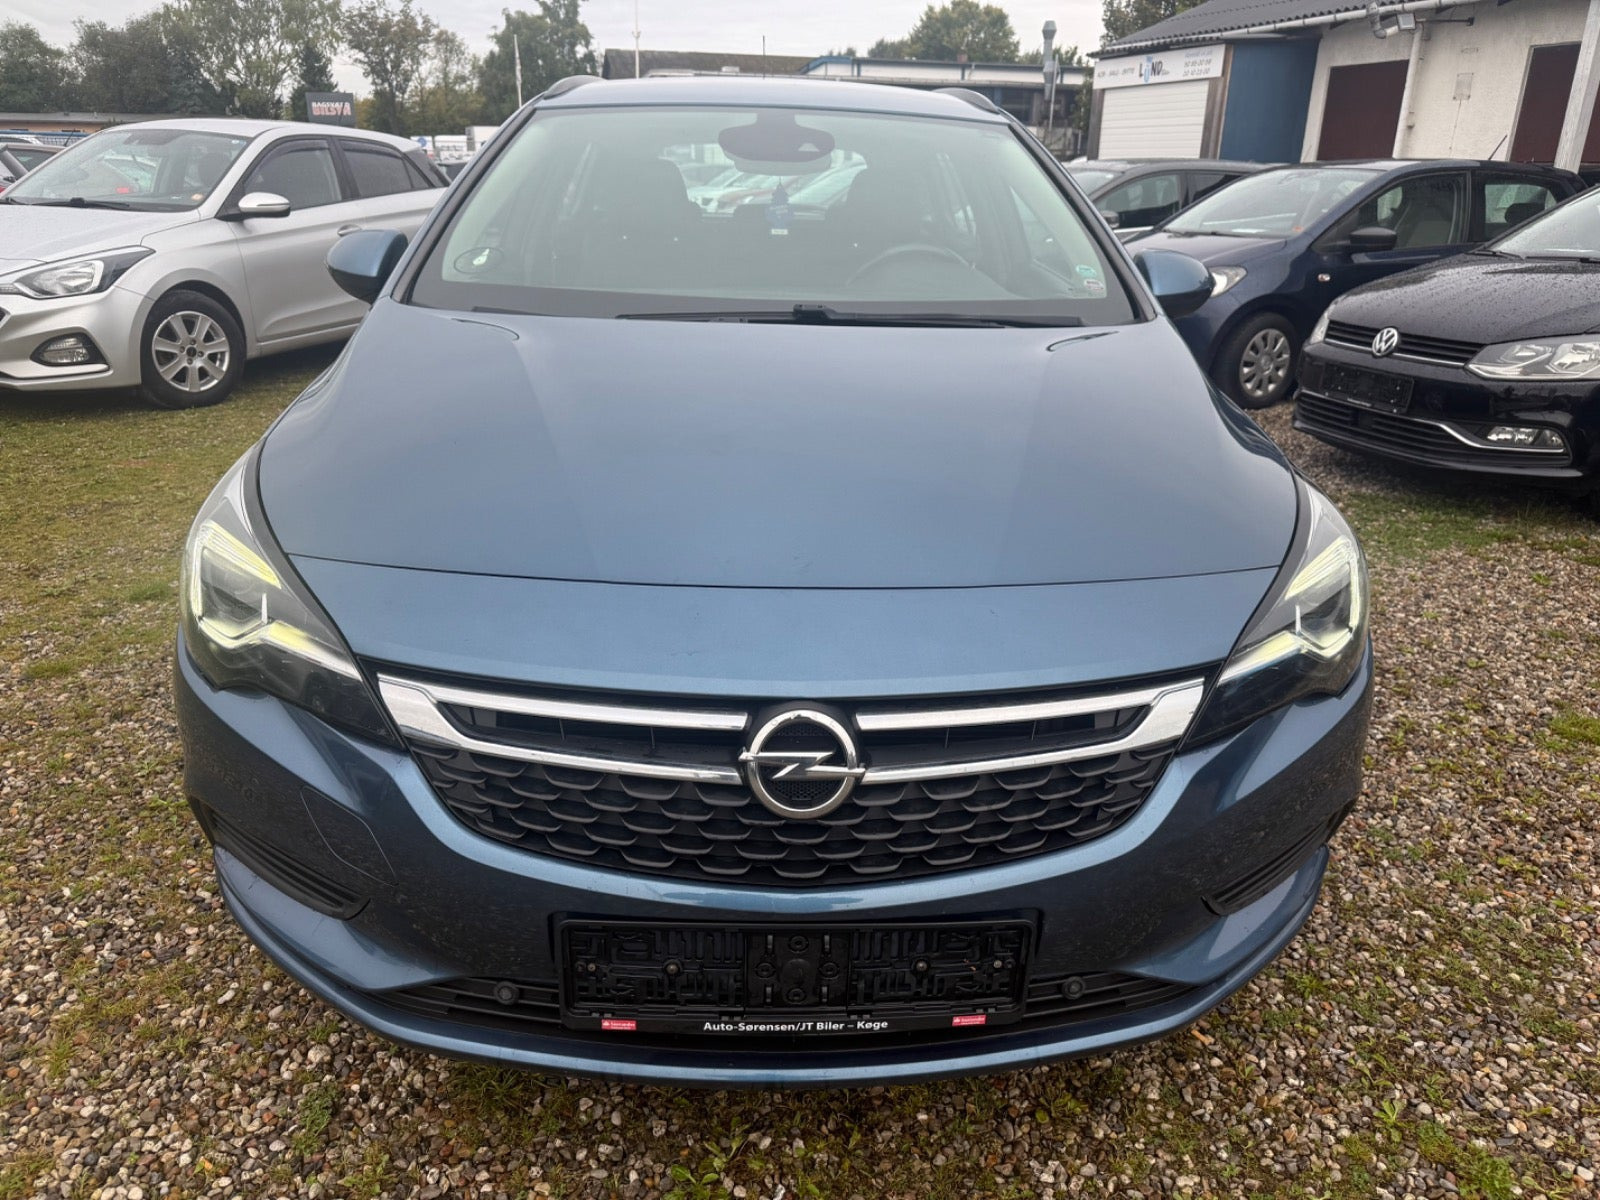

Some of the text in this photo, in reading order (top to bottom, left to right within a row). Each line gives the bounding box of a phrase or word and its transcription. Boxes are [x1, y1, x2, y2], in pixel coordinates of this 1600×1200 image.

[703, 1021, 814, 1032] Auto-Sørensen/JT
[816, 1021, 845, 1031] Biler
[856, 1020, 889, 1032] Køge
